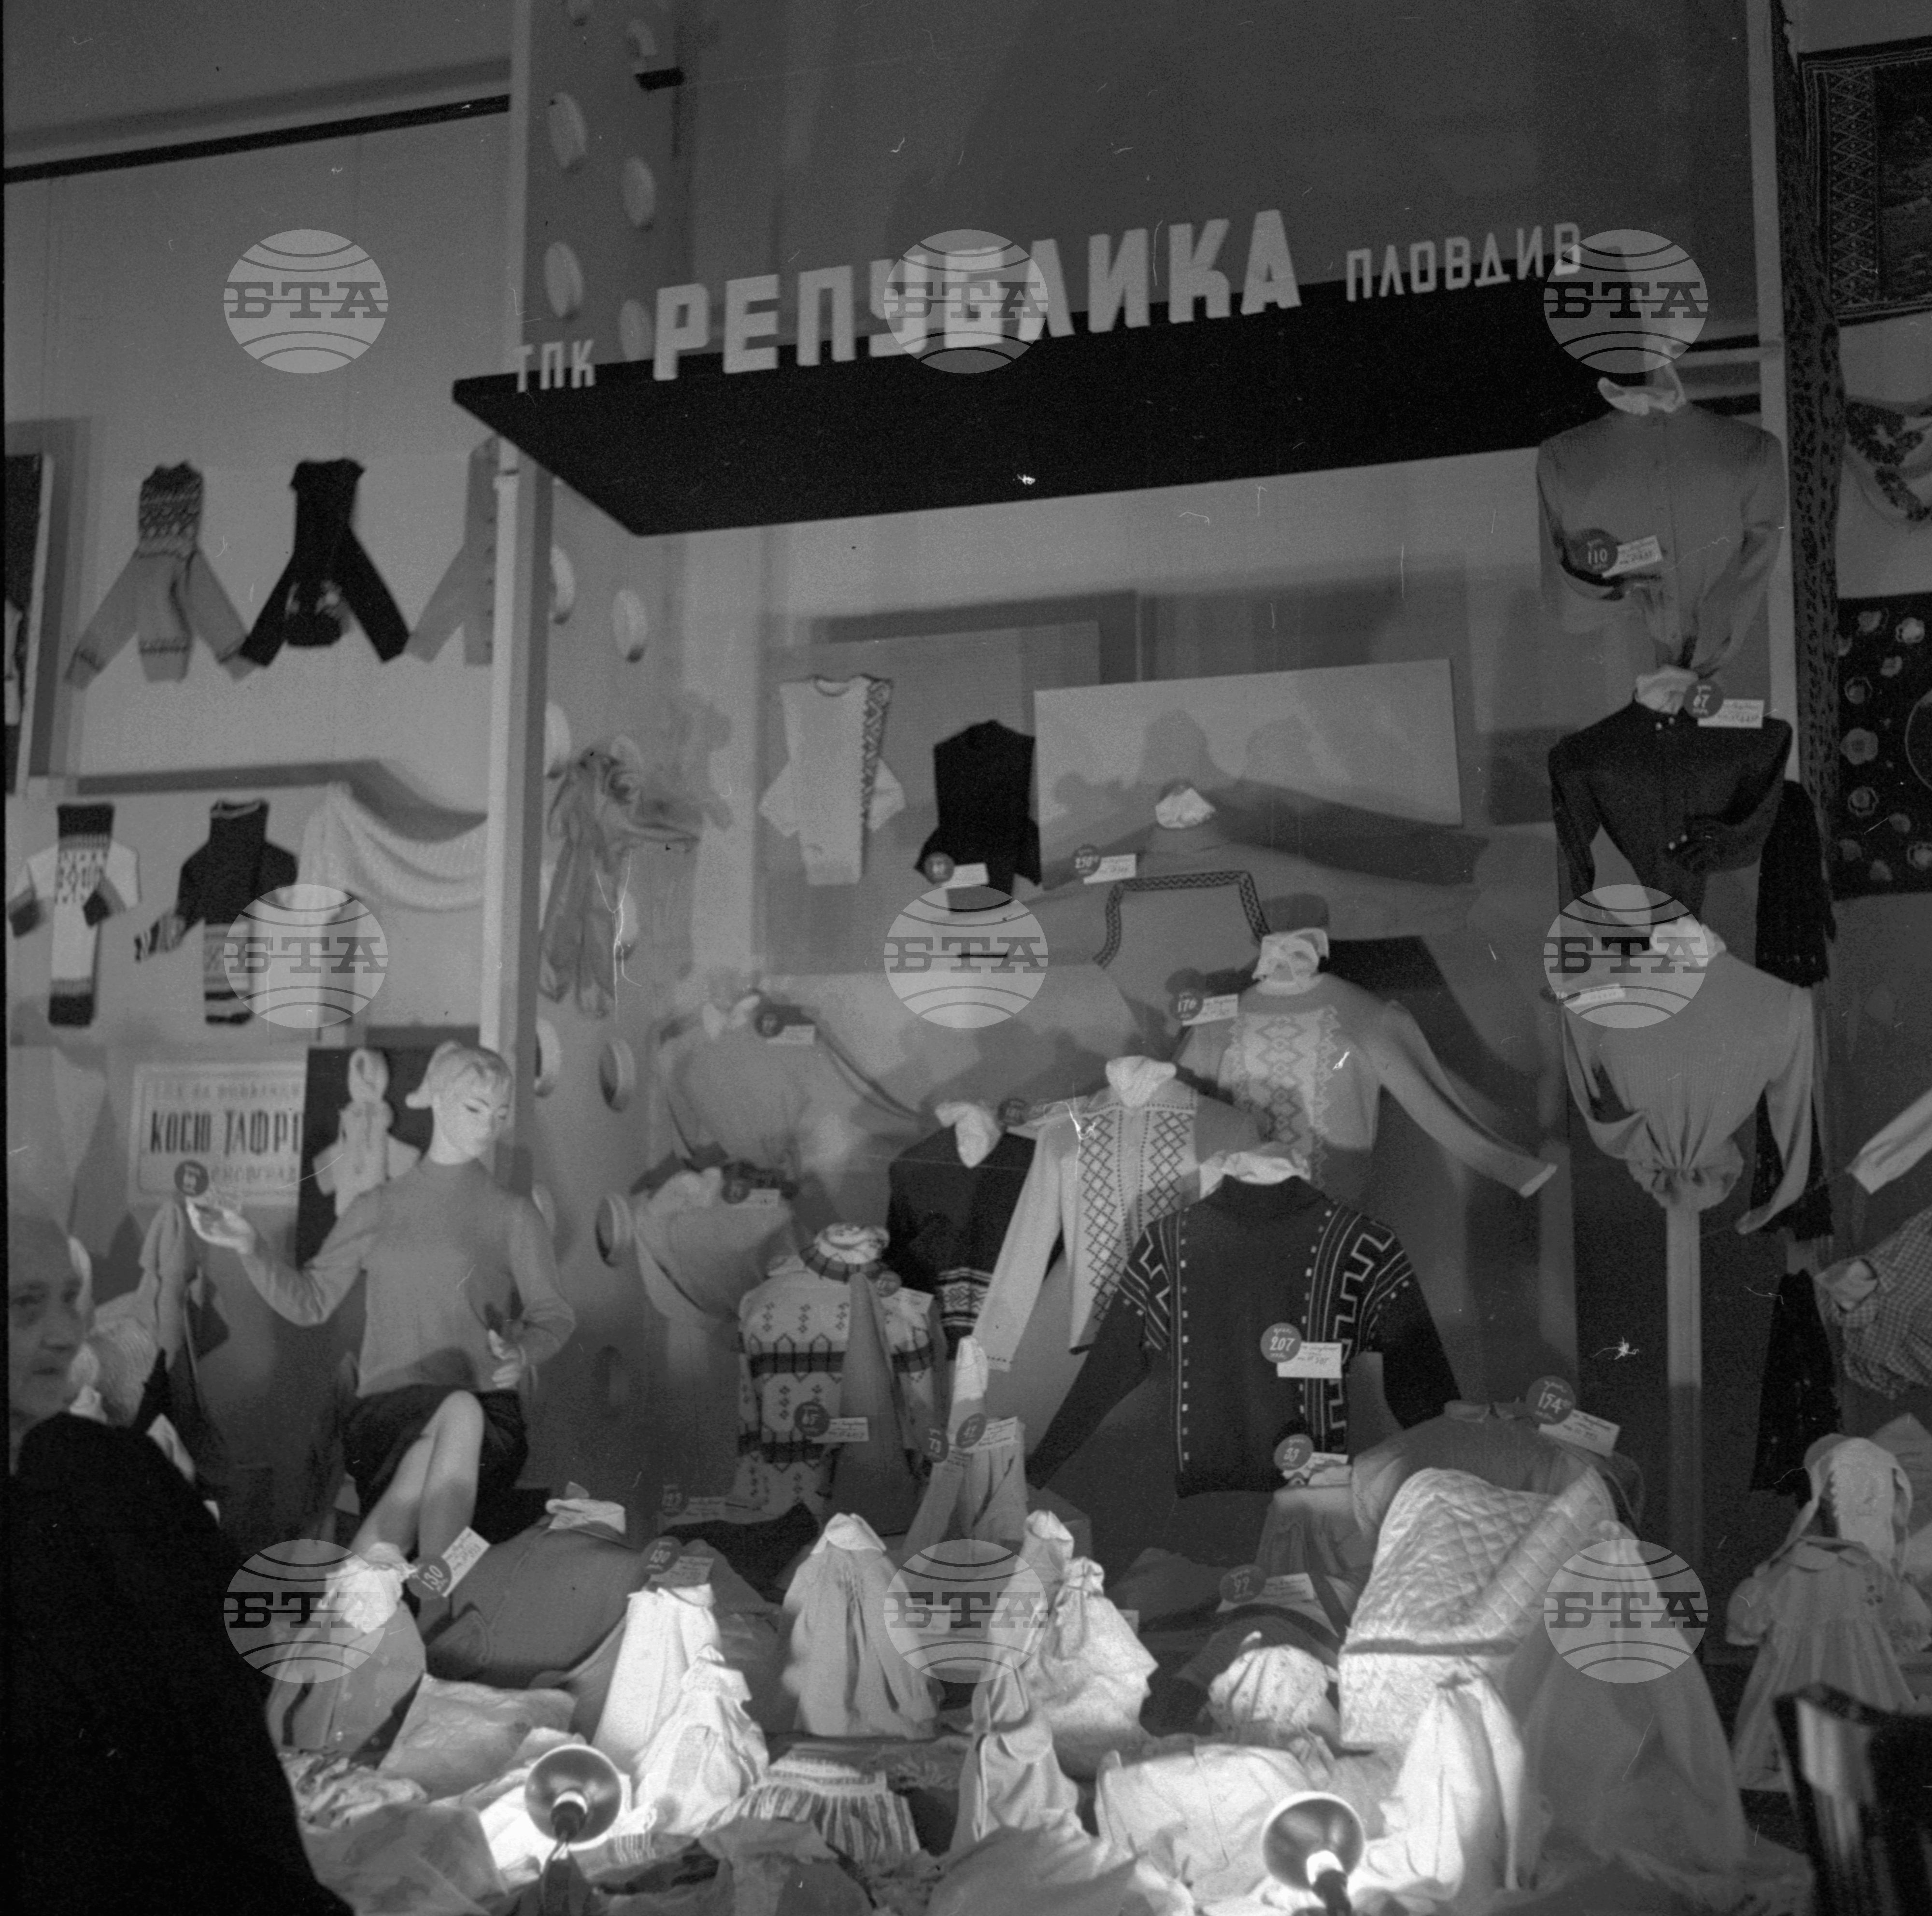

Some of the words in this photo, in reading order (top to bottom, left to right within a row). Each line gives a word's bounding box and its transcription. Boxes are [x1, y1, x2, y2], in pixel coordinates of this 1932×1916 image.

[514, 340, 596, 393] ТПК
[653, 209, 1302, 381] РЕПУБЛИКА
[1347, 222, 1581, 302] ПЛОВДИВ
[1270, 1336, 1295, 1351] 207
[421, 1565, 443, 1590] 130
